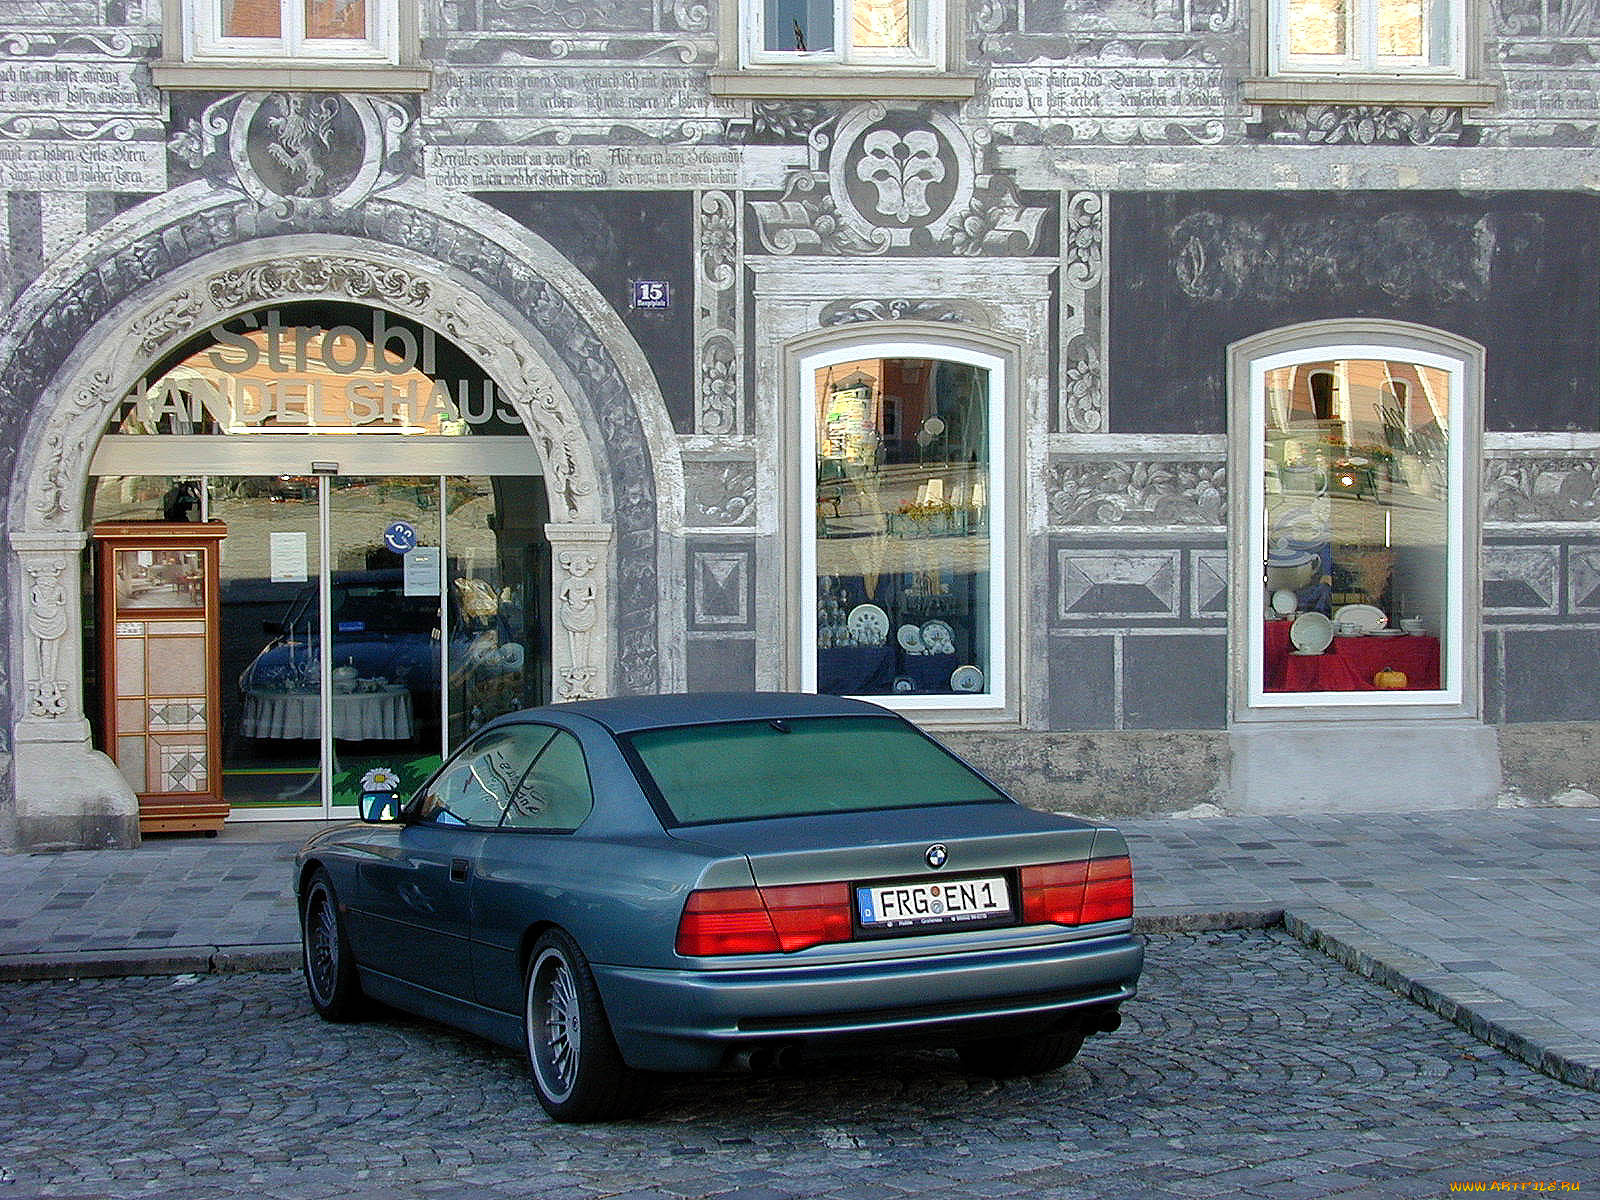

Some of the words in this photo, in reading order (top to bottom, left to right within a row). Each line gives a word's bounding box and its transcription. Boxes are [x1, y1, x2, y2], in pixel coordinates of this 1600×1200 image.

[640, 284, 663, 300] 15
[208, 310, 436, 374] Strobl
[111, 378, 522, 424] HANDELSHAUS
[880, 888, 930, 917] FRG
